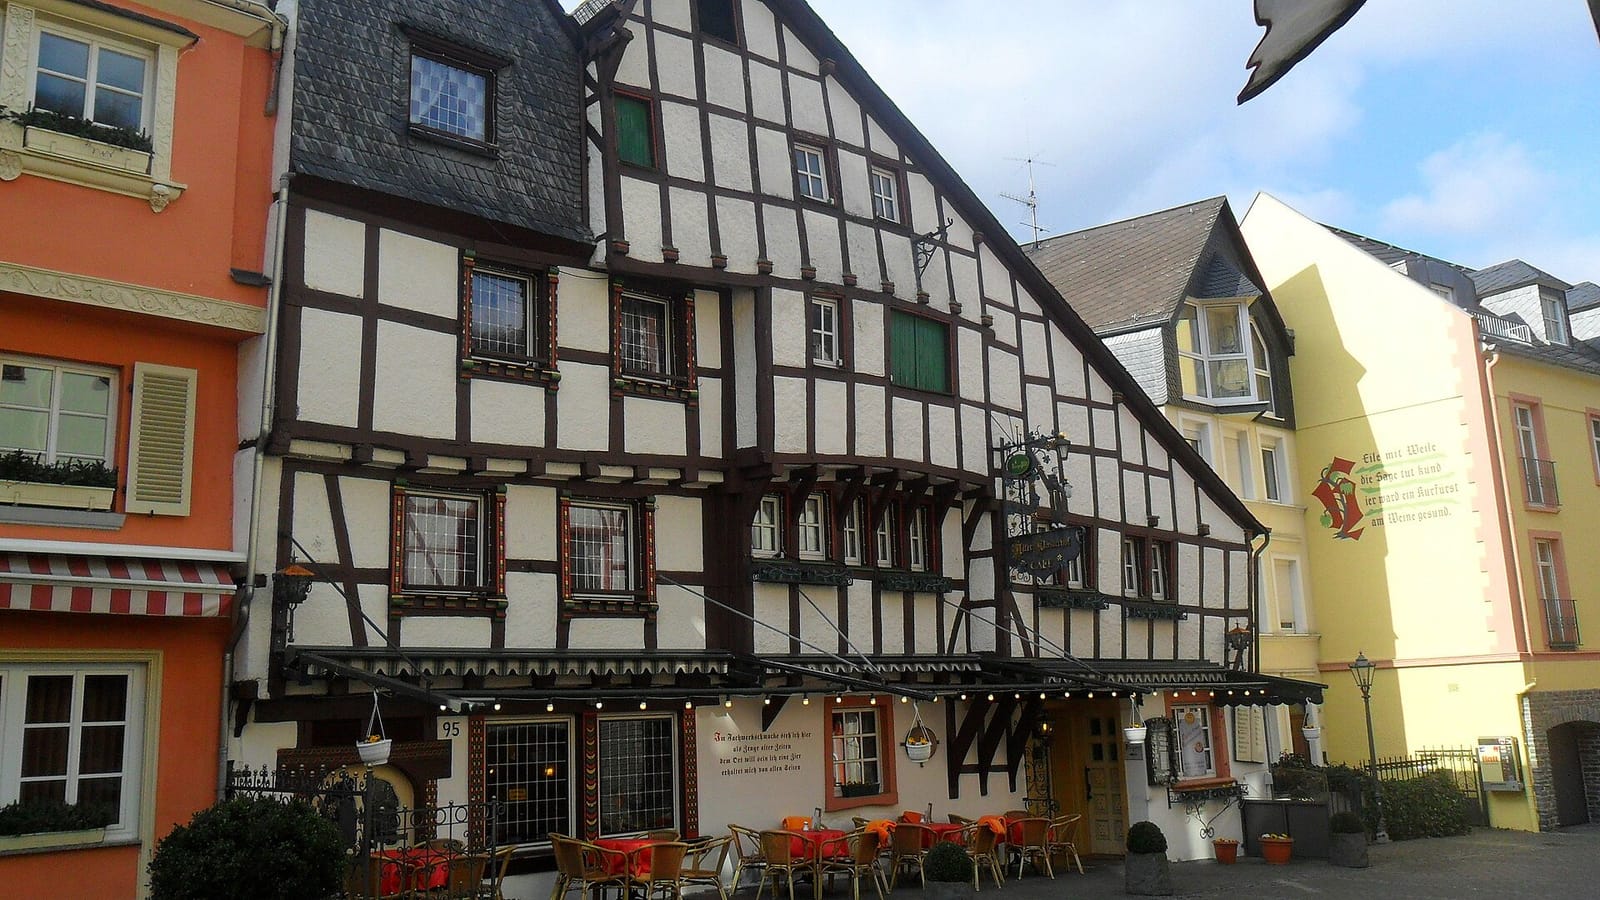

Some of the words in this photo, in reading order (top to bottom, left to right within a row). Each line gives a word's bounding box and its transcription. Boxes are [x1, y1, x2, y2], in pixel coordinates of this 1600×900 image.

[1363, 453, 1380, 463] Eile
[1386, 450, 1402, 460] mit
[1407, 443, 1436, 455] Weile
[1361, 475, 1372, 485] die
[1375, 472, 1398, 482] Sage
[1401, 468, 1415, 478] tut
[1379, 492, 1399, 504] ward
[1402, 491, 1414, 500] ein
[1372, 518, 1384, 526] am
[1388, 512, 1415, 523] Weine
[443, 722, 459, 736] 95
[715, 732, 725, 742] Im
